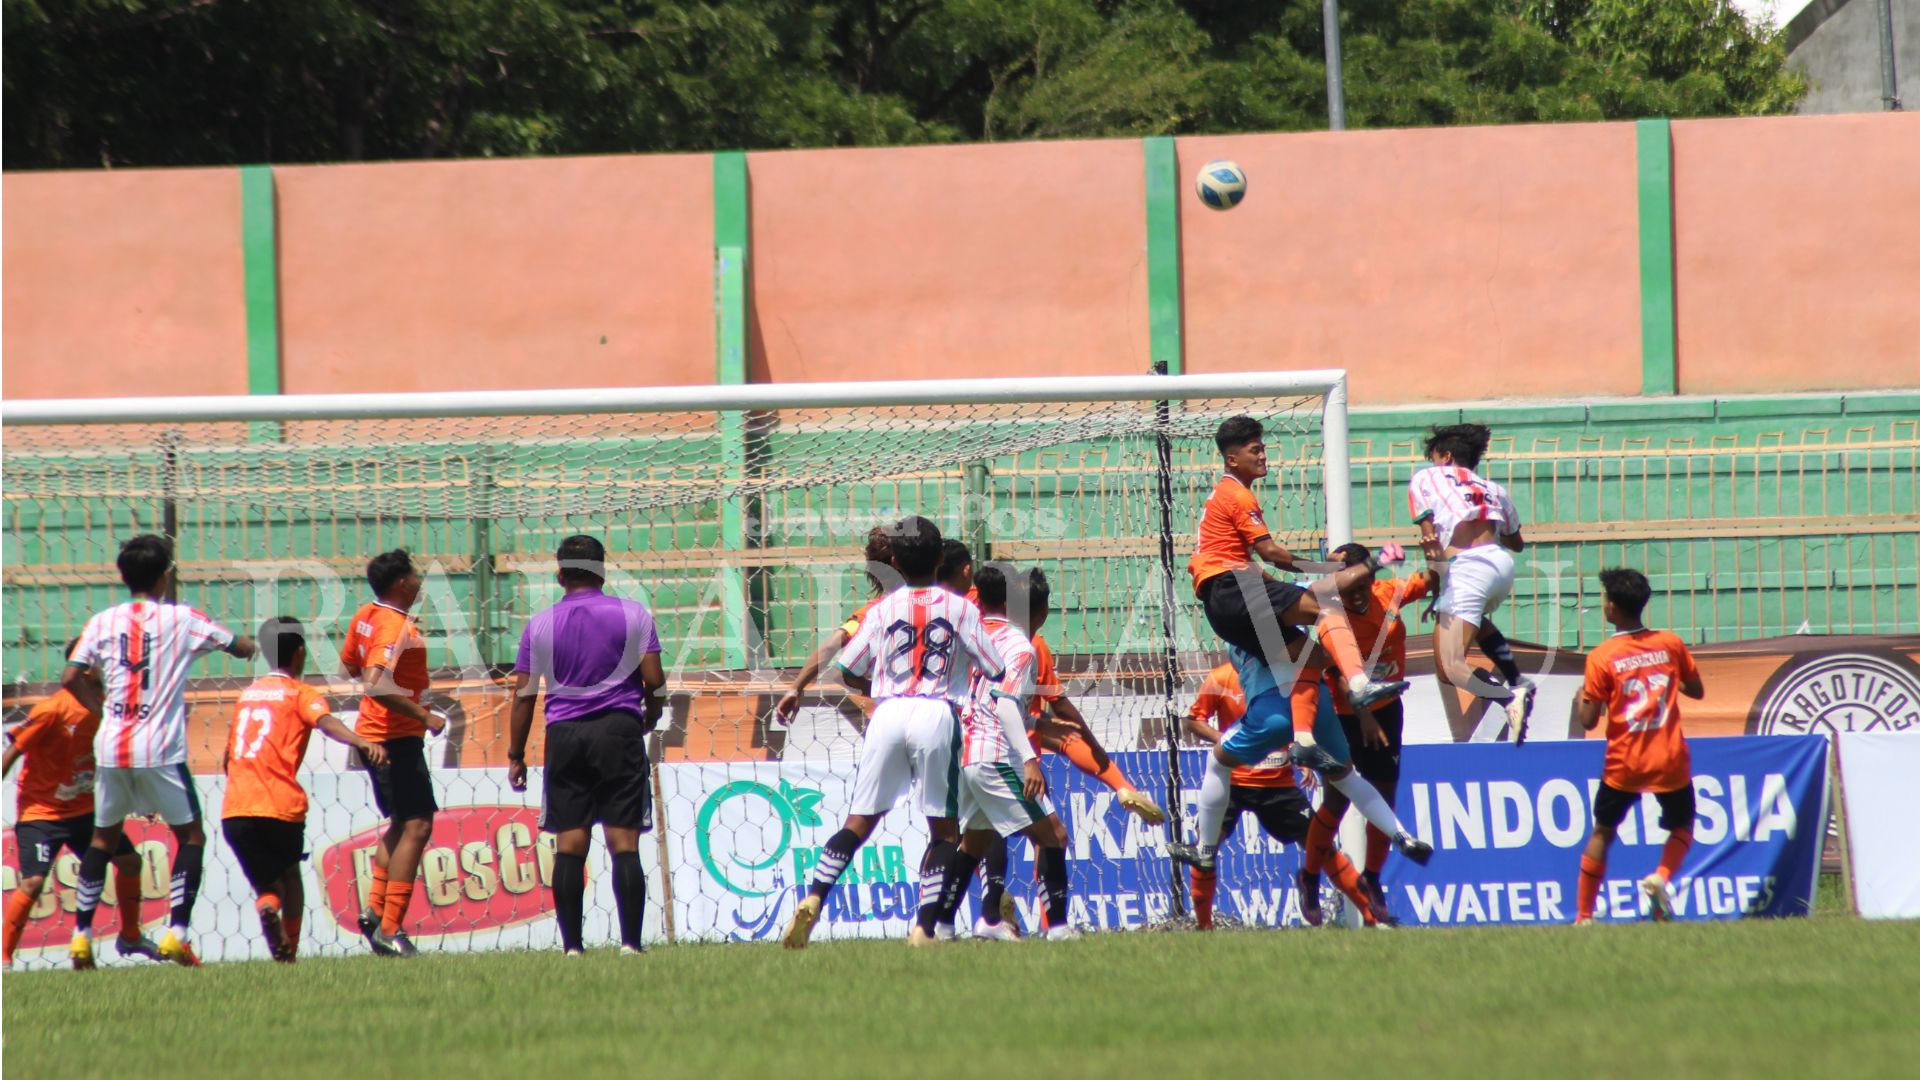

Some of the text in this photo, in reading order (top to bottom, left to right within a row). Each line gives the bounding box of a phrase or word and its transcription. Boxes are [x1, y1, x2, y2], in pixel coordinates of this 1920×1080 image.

[120, 631, 151, 691] 4
[887, 616, 955, 684] 28
[113, 702, 151, 720] RMS
[352, 822, 559, 914] FesCo
[792, 845, 908, 885] PAR
[795, 881, 921, 923] AL.CO
[1406, 880, 1565, 924] WATER
